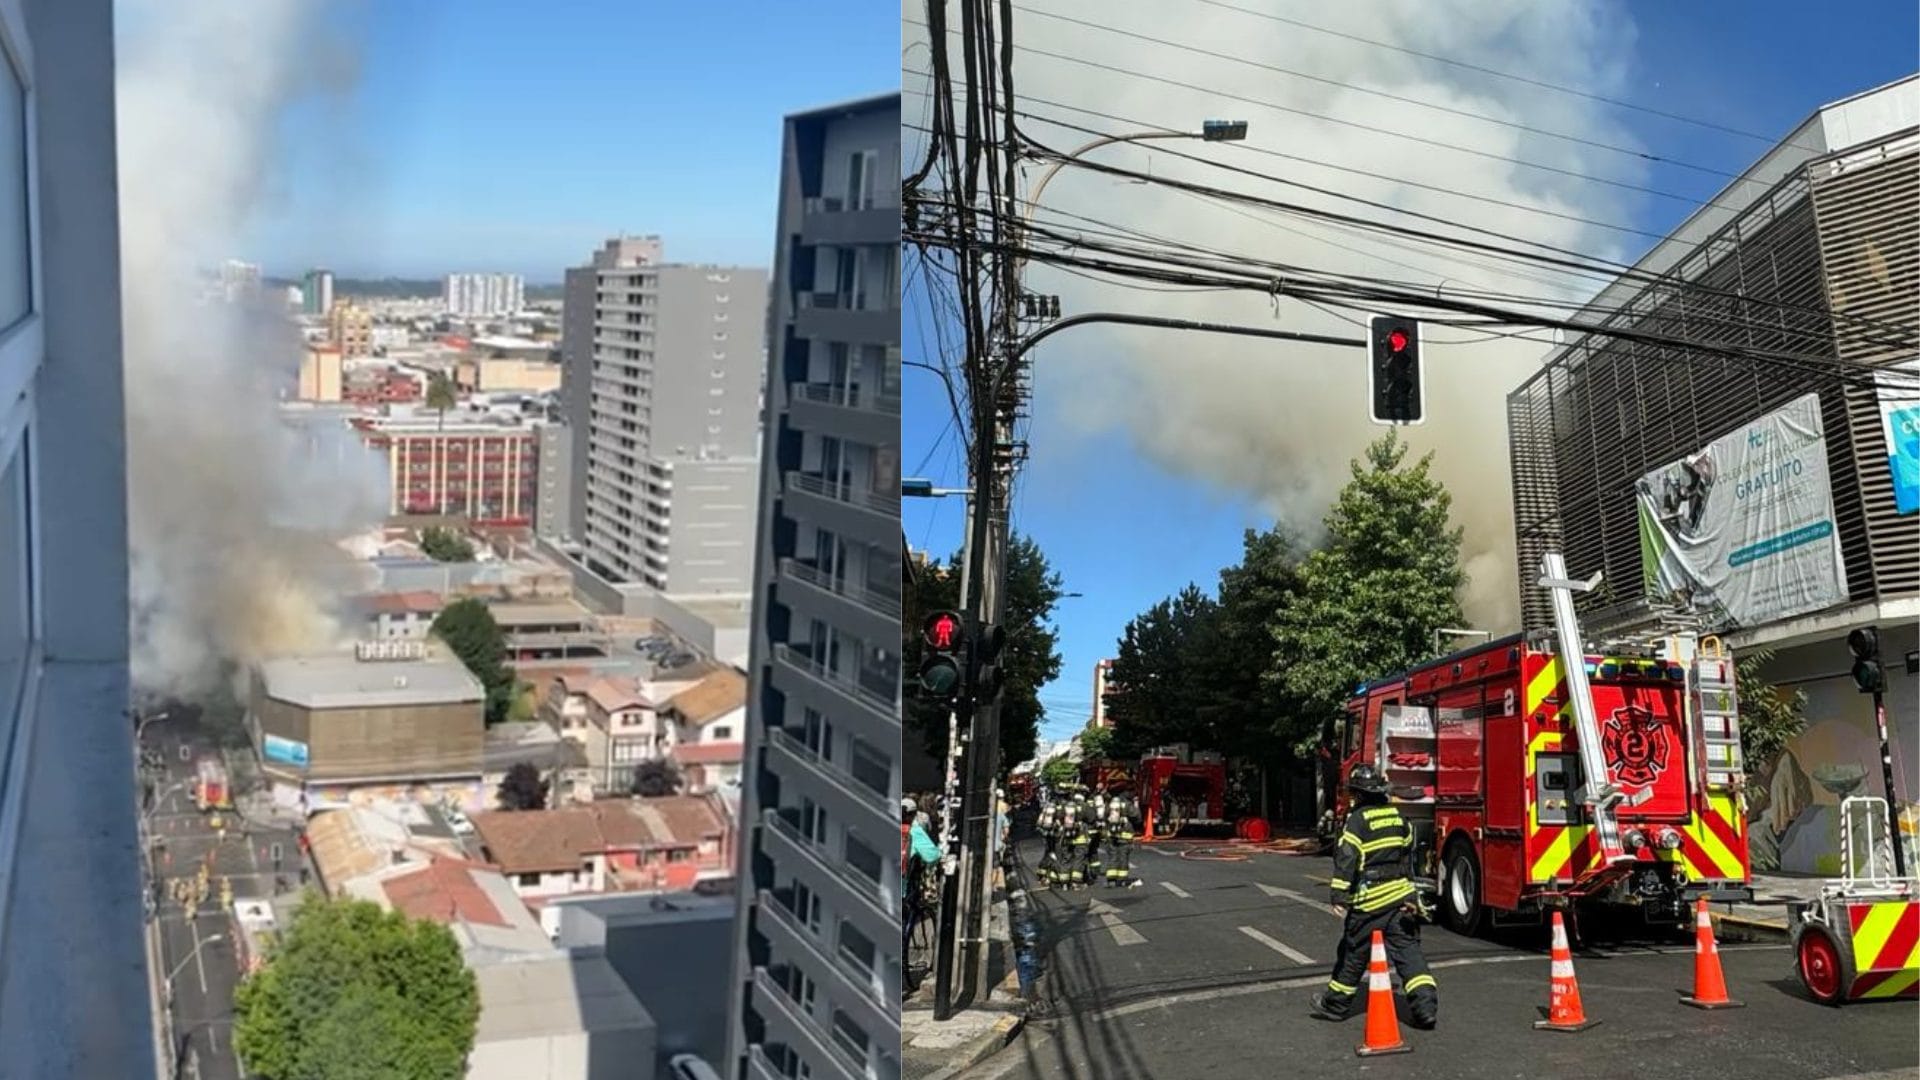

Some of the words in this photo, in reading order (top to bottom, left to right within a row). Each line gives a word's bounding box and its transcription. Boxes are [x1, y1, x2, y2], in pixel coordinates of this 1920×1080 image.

[1736, 458, 1802, 500] GRATUITO
[1504, 688, 1515, 716] 2
[1627, 733, 1645, 757] 2
